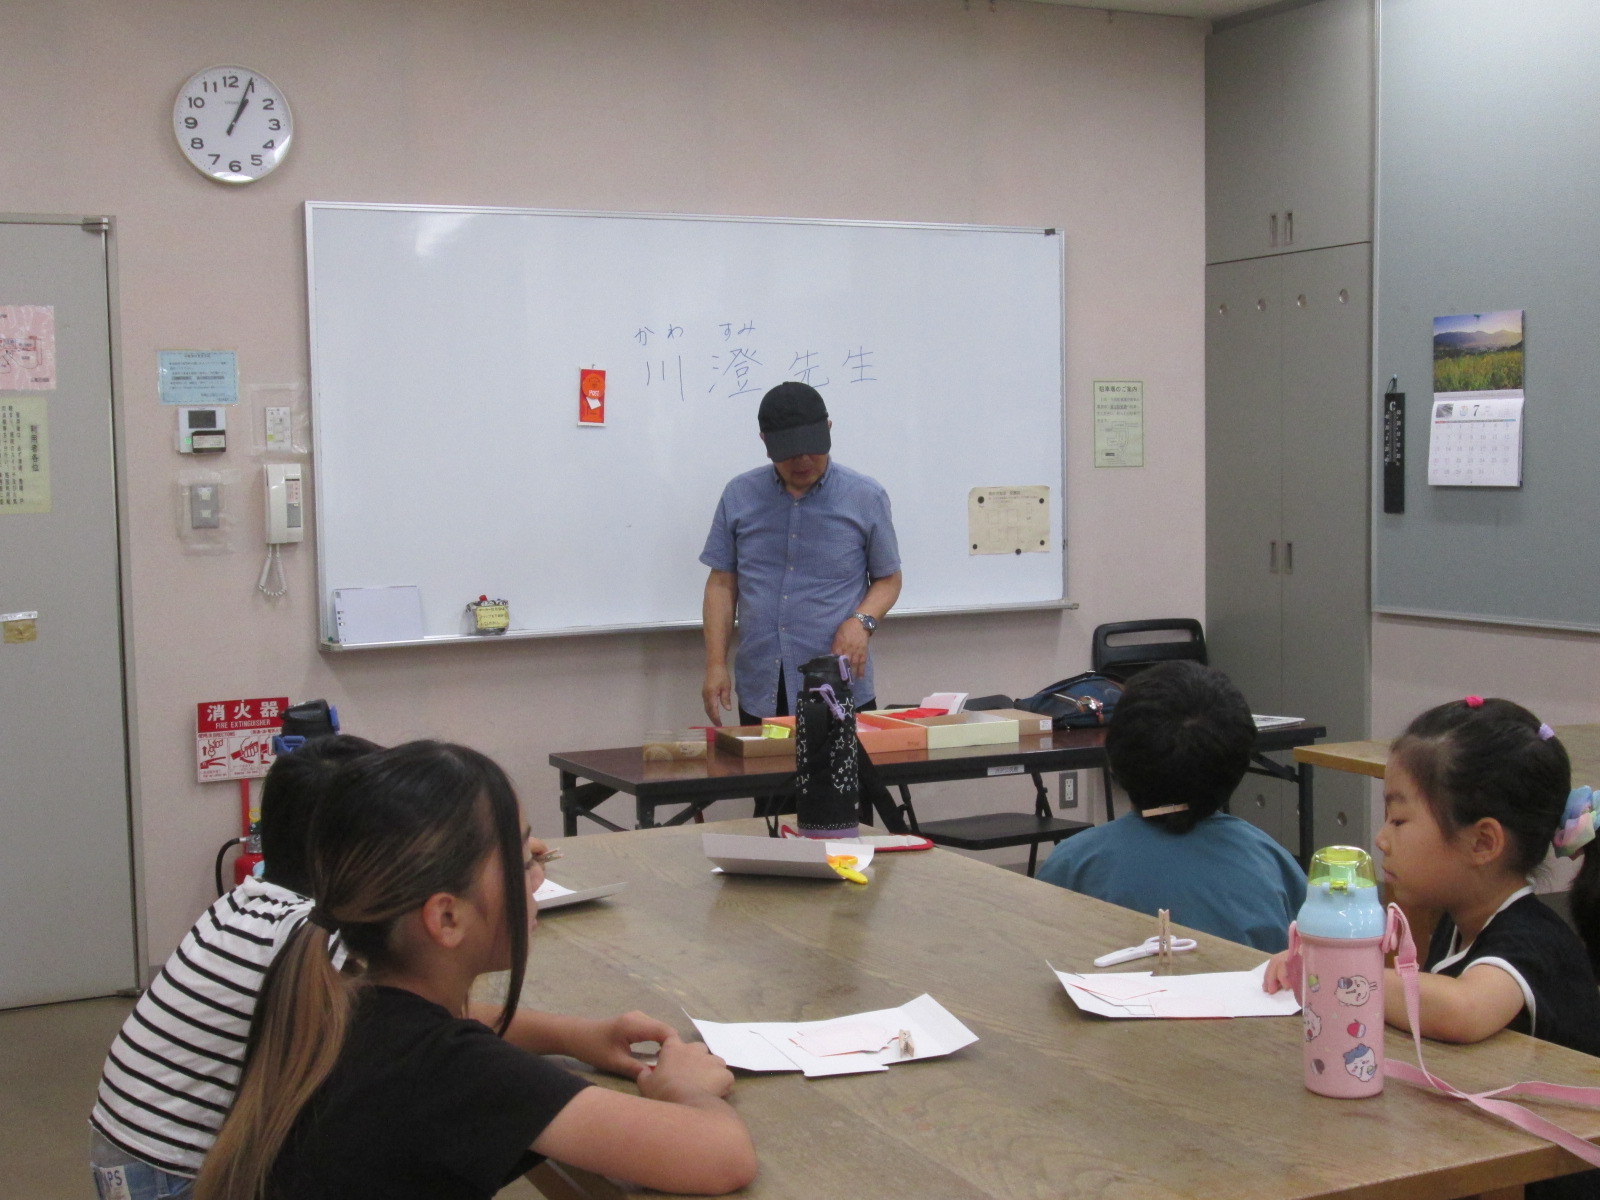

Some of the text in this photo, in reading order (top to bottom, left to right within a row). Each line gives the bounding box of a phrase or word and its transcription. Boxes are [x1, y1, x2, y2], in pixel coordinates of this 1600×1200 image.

[203, 81, 218, 93] 11
[222, 76, 239, 88] 12
[188, 96, 205, 109] 10
[262, 98, 275, 111] 2
[184, 116, 198, 130] 9
[268, 118, 281, 131] 3
[190, 138, 204, 150] 8
[262, 139, 275, 150] 4
[208, 154, 221, 166] 7
[228, 160, 242, 173] 6
[251, 154, 263, 167] 5
[634, 319, 756, 346] かわ すみ
[1473, 404, 1480, 417] 7
[207, 700, 279, 722] 消火器
[230, 719, 271, 728] EXTINGUISHER
